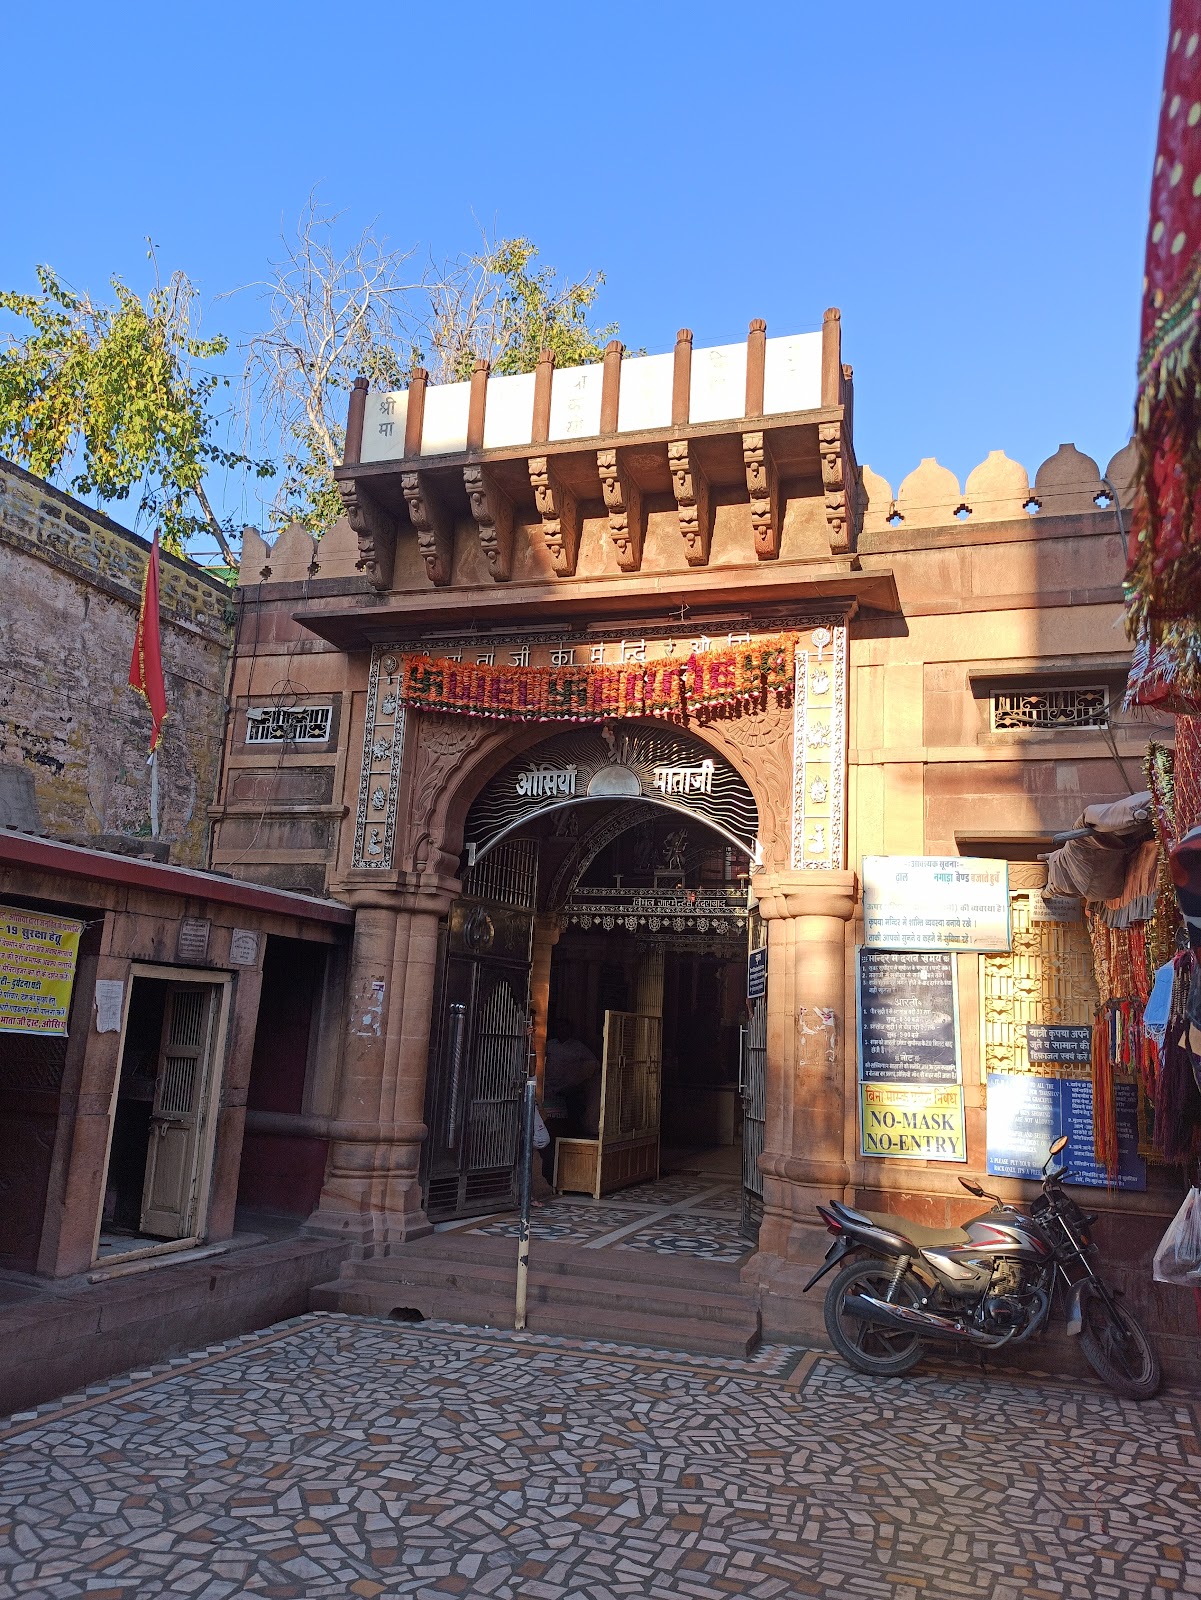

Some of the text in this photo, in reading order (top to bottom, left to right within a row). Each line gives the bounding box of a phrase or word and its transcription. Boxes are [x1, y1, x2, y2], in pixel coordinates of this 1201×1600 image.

[379, 396, 396, 415] श्री
[378, 422, 394, 437] मा
[6, 925, 18, 935] 19
[22, 927, 48, 940] सुरक्षा
[17, 1016, 26, 1026] जी
[1029, 1027, 1089, 1040] यात्री कृपया अपने
[1030, 1039, 1042, 1050] जूते
[1051, 1041, 1078, 1049] सामान
[1080, 1040, 1090, 1049] की
[870, 1111, 954, 1130] NO-MASK
[866, 1133, 959, 1153] NO-ENTRY
